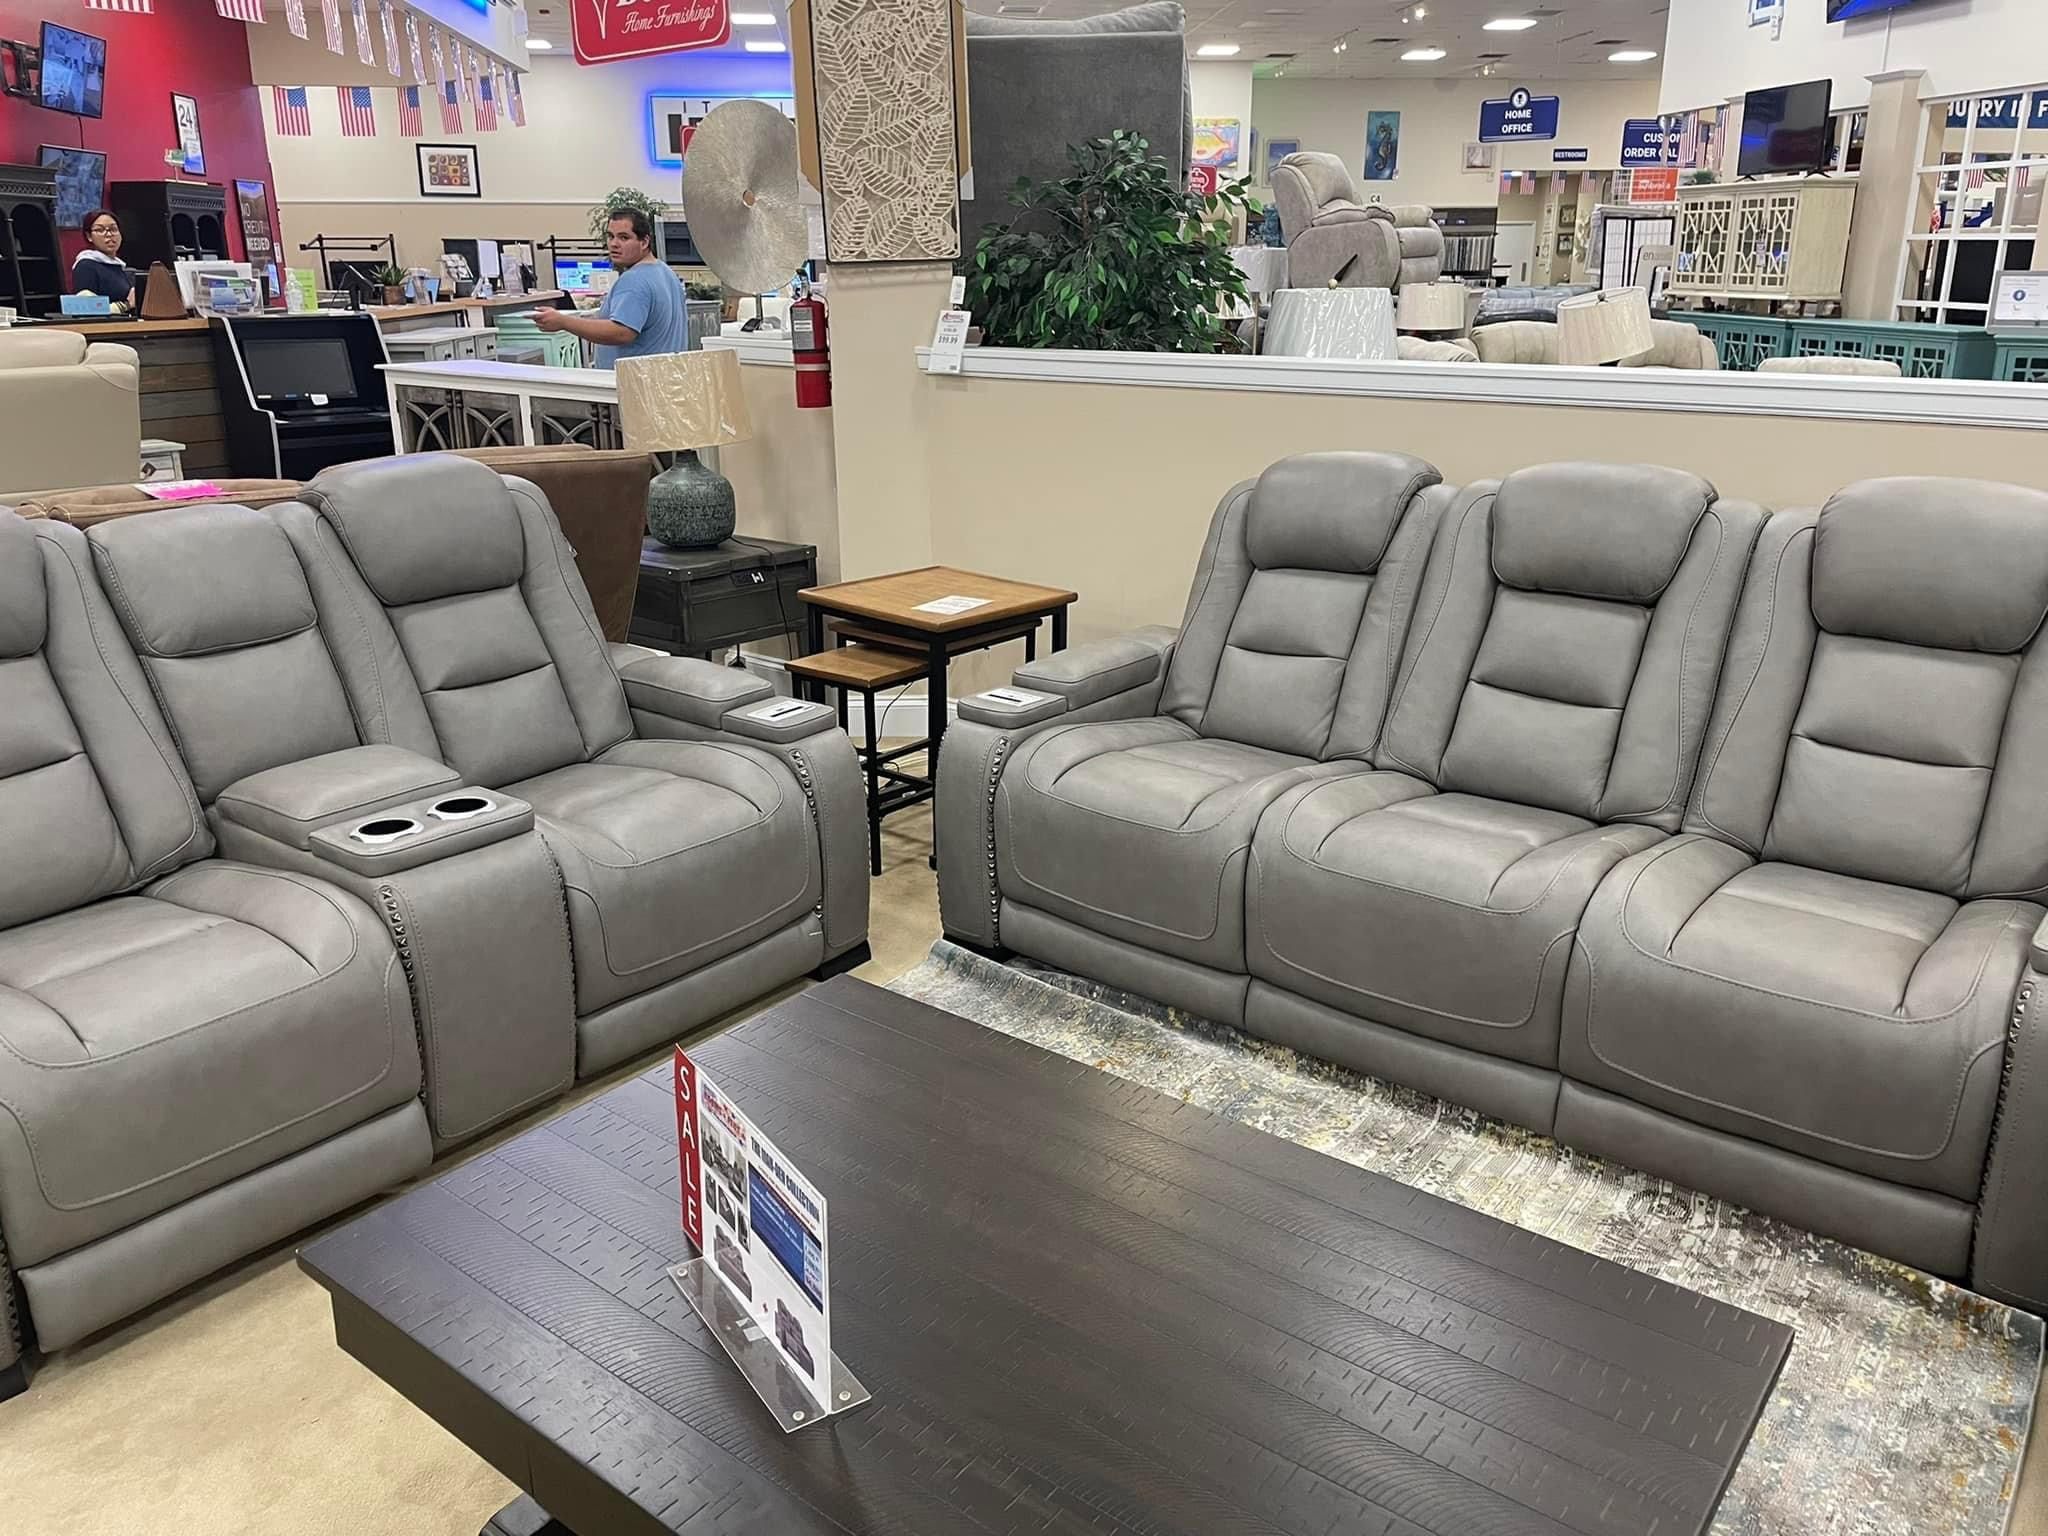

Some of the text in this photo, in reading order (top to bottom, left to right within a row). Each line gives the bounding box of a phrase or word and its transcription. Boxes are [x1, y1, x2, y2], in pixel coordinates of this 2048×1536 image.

[621, 11, 653, 34] Home
[653, 1, 716, 31] Furnishings
[178, 104, 193, 127] 24
[1505, 109, 1532, 119] HOME
[1501, 122, 1533, 133] OFFICE
[1643, 133, 1681, 143] CUSO
[1624, 147, 1656, 157] ORDER
[246, 237, 270, 250] NEEDED
[680, 1066, 698, 1235] SALE
